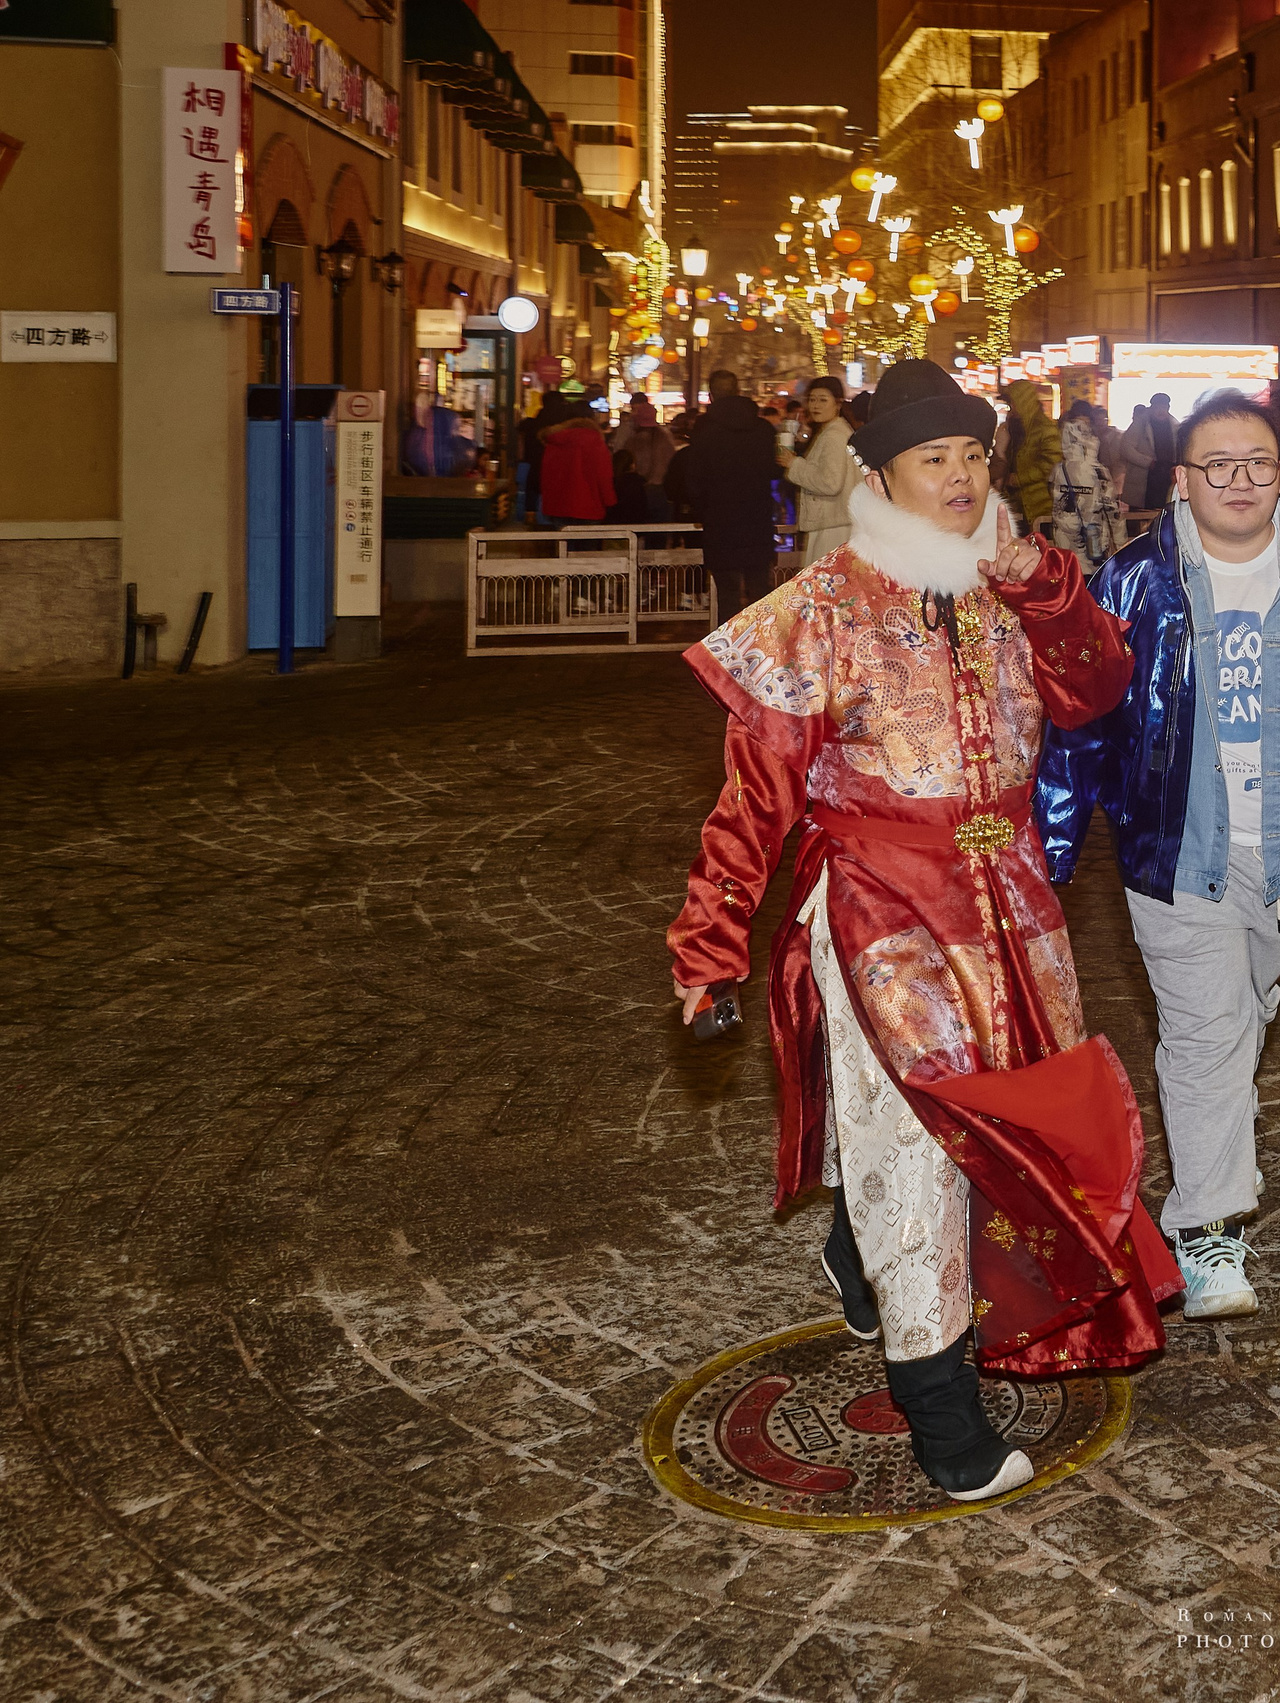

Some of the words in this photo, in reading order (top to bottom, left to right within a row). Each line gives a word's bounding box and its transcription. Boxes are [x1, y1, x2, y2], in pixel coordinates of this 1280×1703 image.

[179, 81, 229, 260] 相遇青岛
[222, 295, 268, 308] 四方路
[25, 327, 92, 346] 四方路
